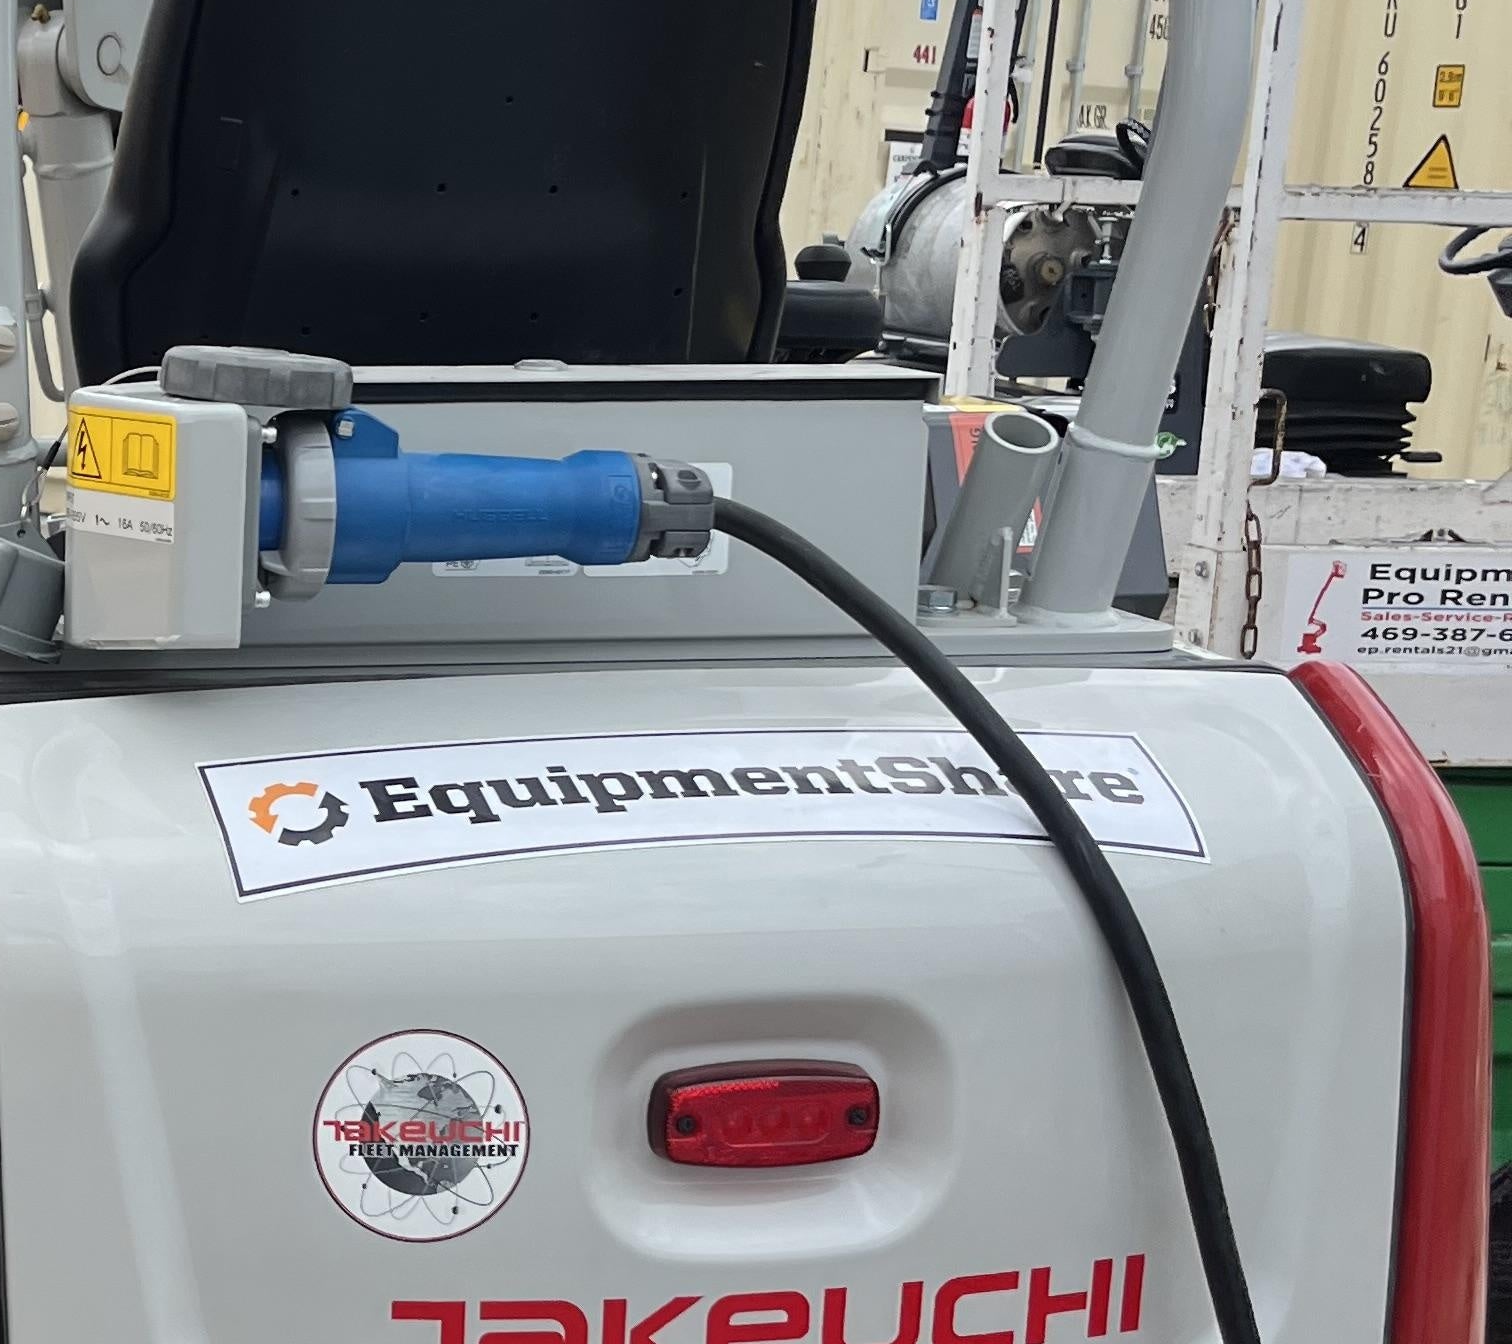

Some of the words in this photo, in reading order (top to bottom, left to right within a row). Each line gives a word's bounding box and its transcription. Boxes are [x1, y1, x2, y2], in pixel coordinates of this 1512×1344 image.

[912, 44, 937, 65] 441
[1361, 587, 1425, 606] Pro
[358, 756, 1146, 828] EquipmentShre
[348, 1143, 395, 1157] FLEET
[398, 1143, 520, 1158] MANAGEMENT
